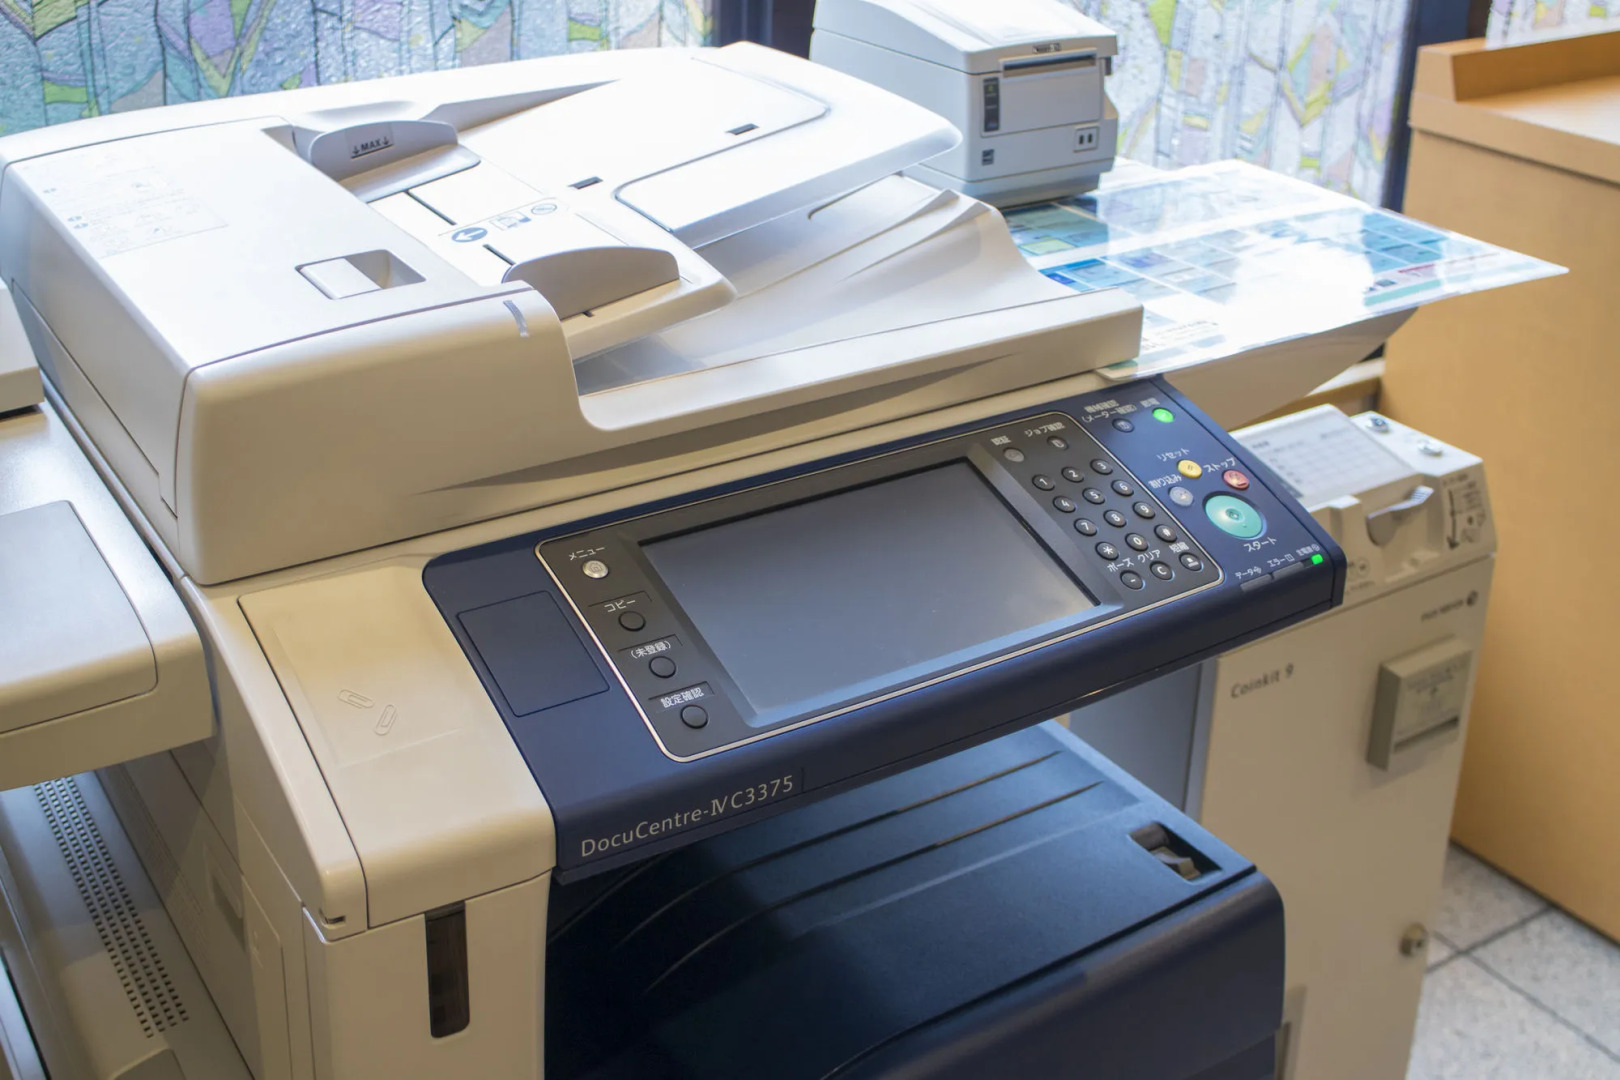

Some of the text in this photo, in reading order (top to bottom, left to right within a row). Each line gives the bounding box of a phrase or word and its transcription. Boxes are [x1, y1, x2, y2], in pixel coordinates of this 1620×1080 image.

[361, 138, 381, 151] MAX
[1156, 447, 1190, 462] リセット
[1068, 470, 1078, 478] 2
[1097, 462, 1107, 470] 3
[1203, 457, 1236, 473] ストップ
[1089, 491, 1099, 499] 5
[1080, 505, 1149, 531] 7 8 9
[1133, 537, 1142, 546] 0
[1243, 536, 1277, 552] スタート
[568, 546, 606, 561] メニュー
[1137, 549, 1161, 564] クリア
[1156, 565, 1167, 575] C
[1266, 557, 1286, 568] エラー
[604, 599, 636, 613] コピー
[630, 640, 671, 659] (未登録)
[1230, 670, 1280, 699] Coinkit
[660, 687, 705, 709] 設定確認
